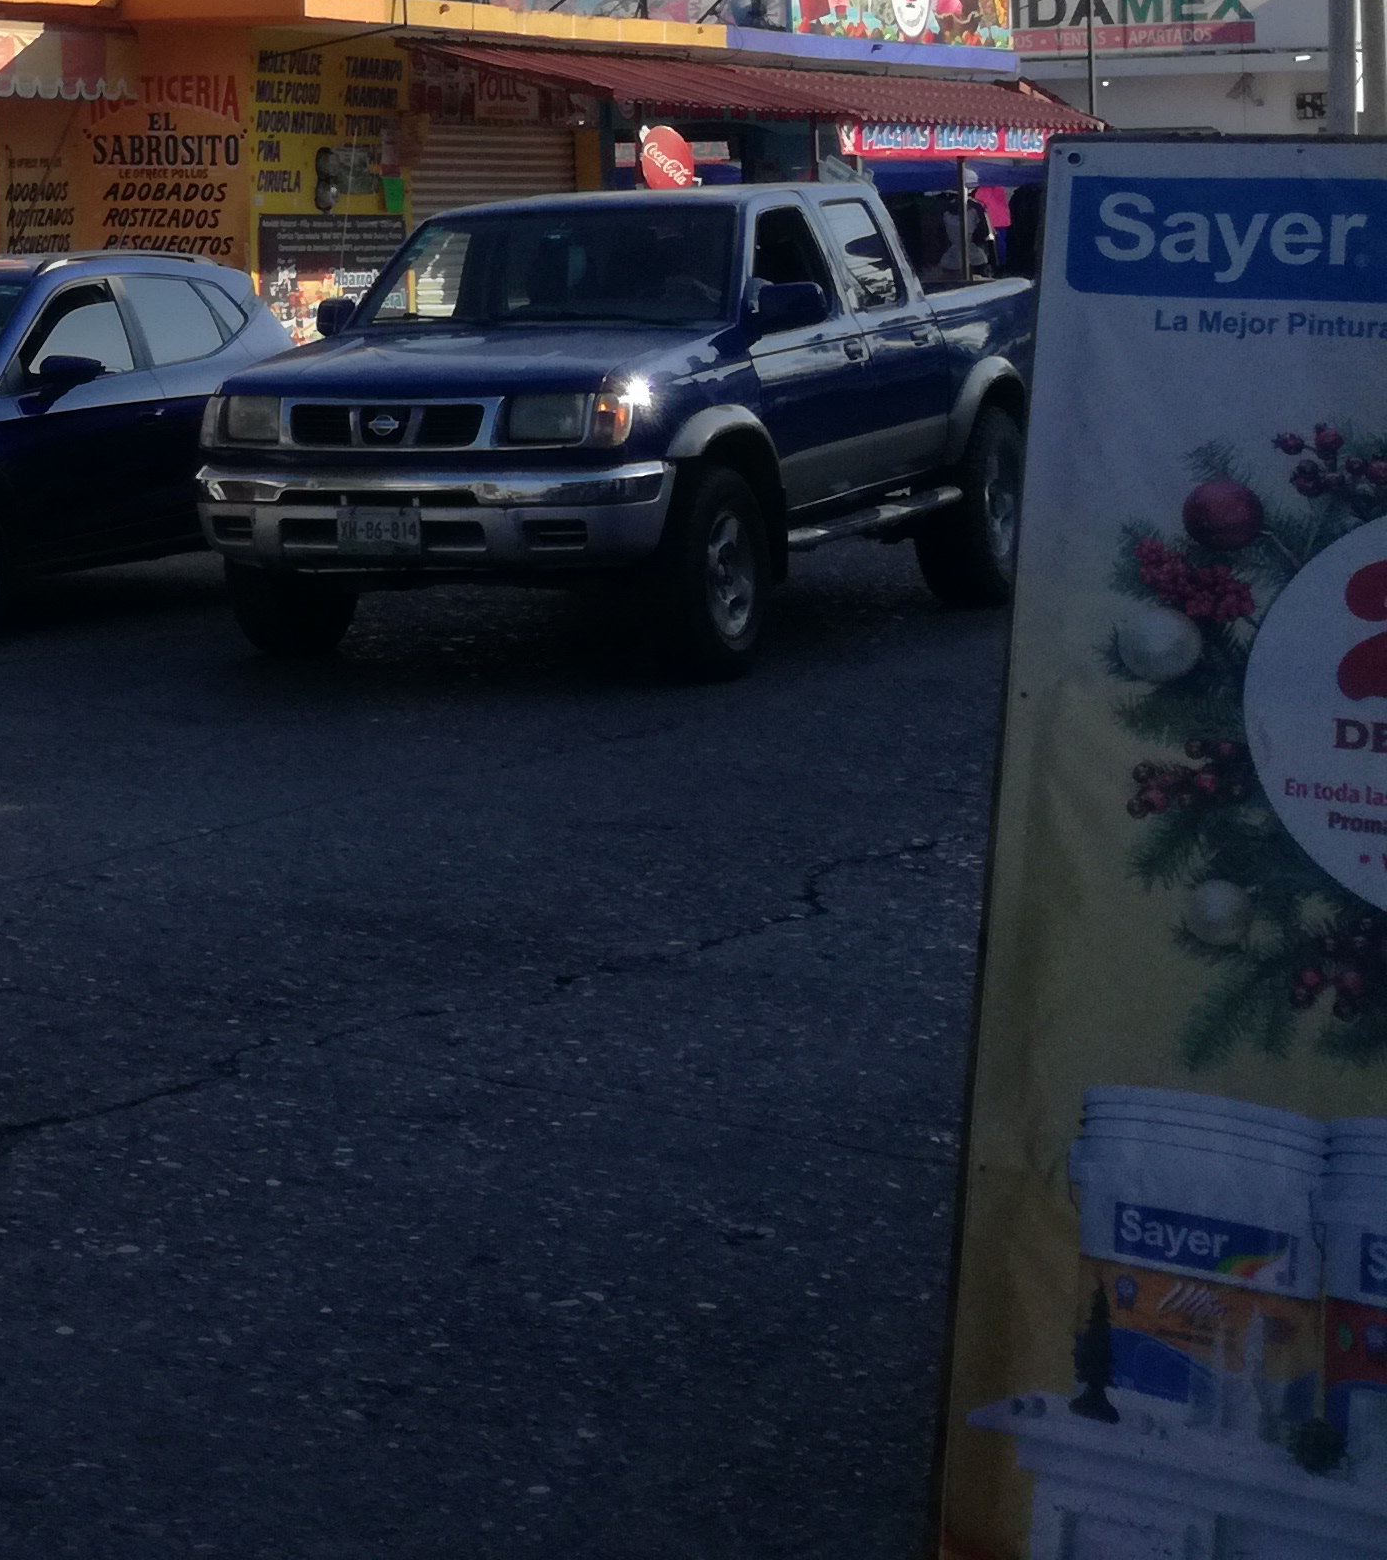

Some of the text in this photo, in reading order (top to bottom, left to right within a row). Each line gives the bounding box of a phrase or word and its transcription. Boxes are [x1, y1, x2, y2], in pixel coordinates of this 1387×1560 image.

[1128, 27, 1213, 45] APARTADOS
[147, 112, 176, 131] EL
[103, 182, 227, 202] ADOBADOS
[102, 208, 222, 228] ROSTIZADOS
[1093, 191, 1367, 284] Sayer
[1154, 309, 1188, 332] La
[1198, 309, 1279, 340] Mejor
[1284, 778, 1308, 798] En
[1314, 783, 1360, 803] toda
[1119, 1209, 1230, 1259] Sayer
